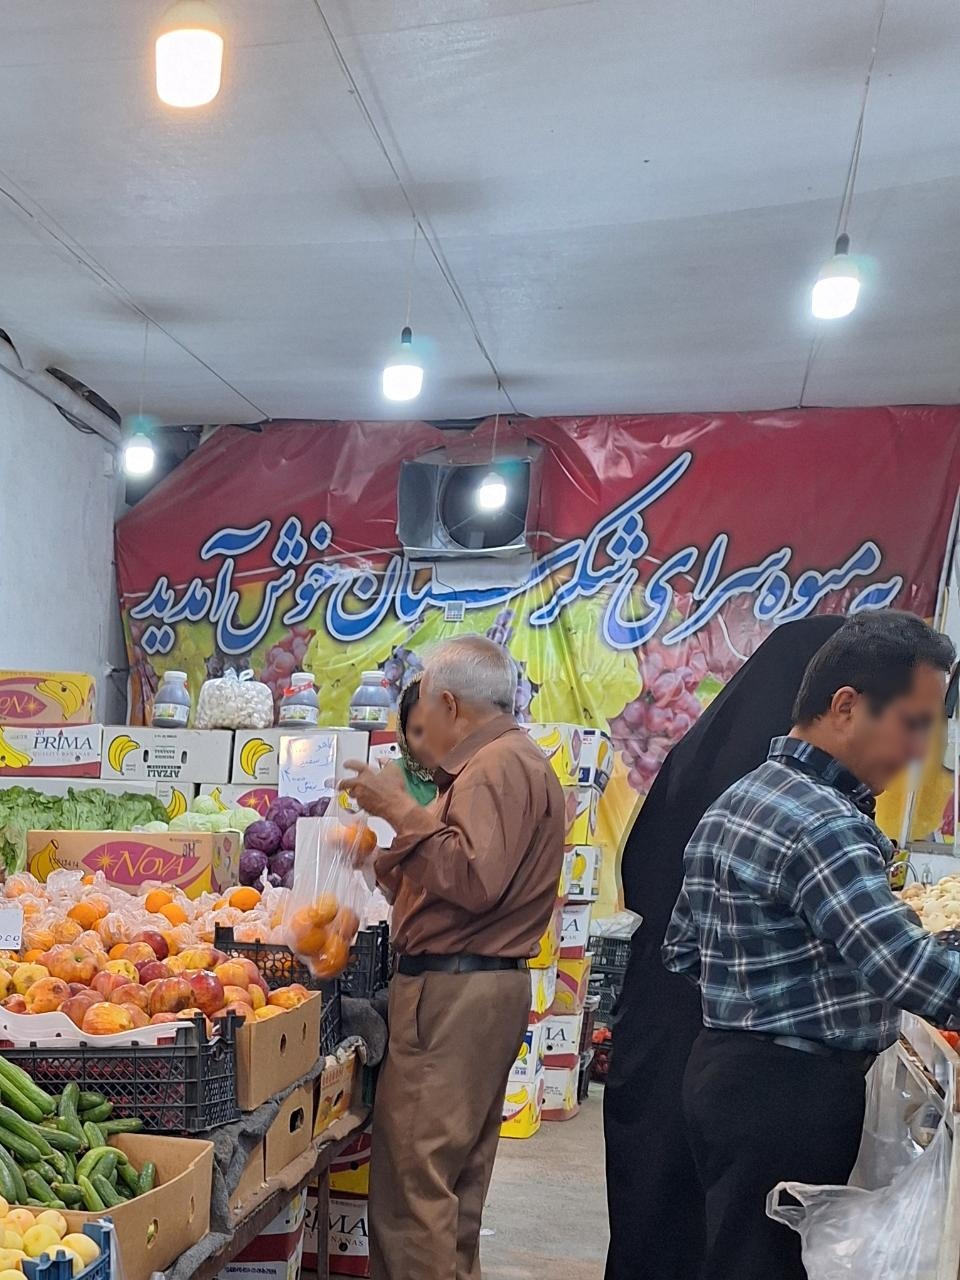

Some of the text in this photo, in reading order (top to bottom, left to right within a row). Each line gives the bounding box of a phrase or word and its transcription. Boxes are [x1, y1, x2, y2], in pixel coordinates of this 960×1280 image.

[130, 520, 271, 654] آمدید
[216, 516, 344, 655] خوش
[602, 533, 792, 650] سرای
[754, 540, 882, 624] میوه
[33, 735, 92, 751] PRIMA
[147, 769, 180, 778] AFZALI
[112, 847, 183, 878] NOVA
